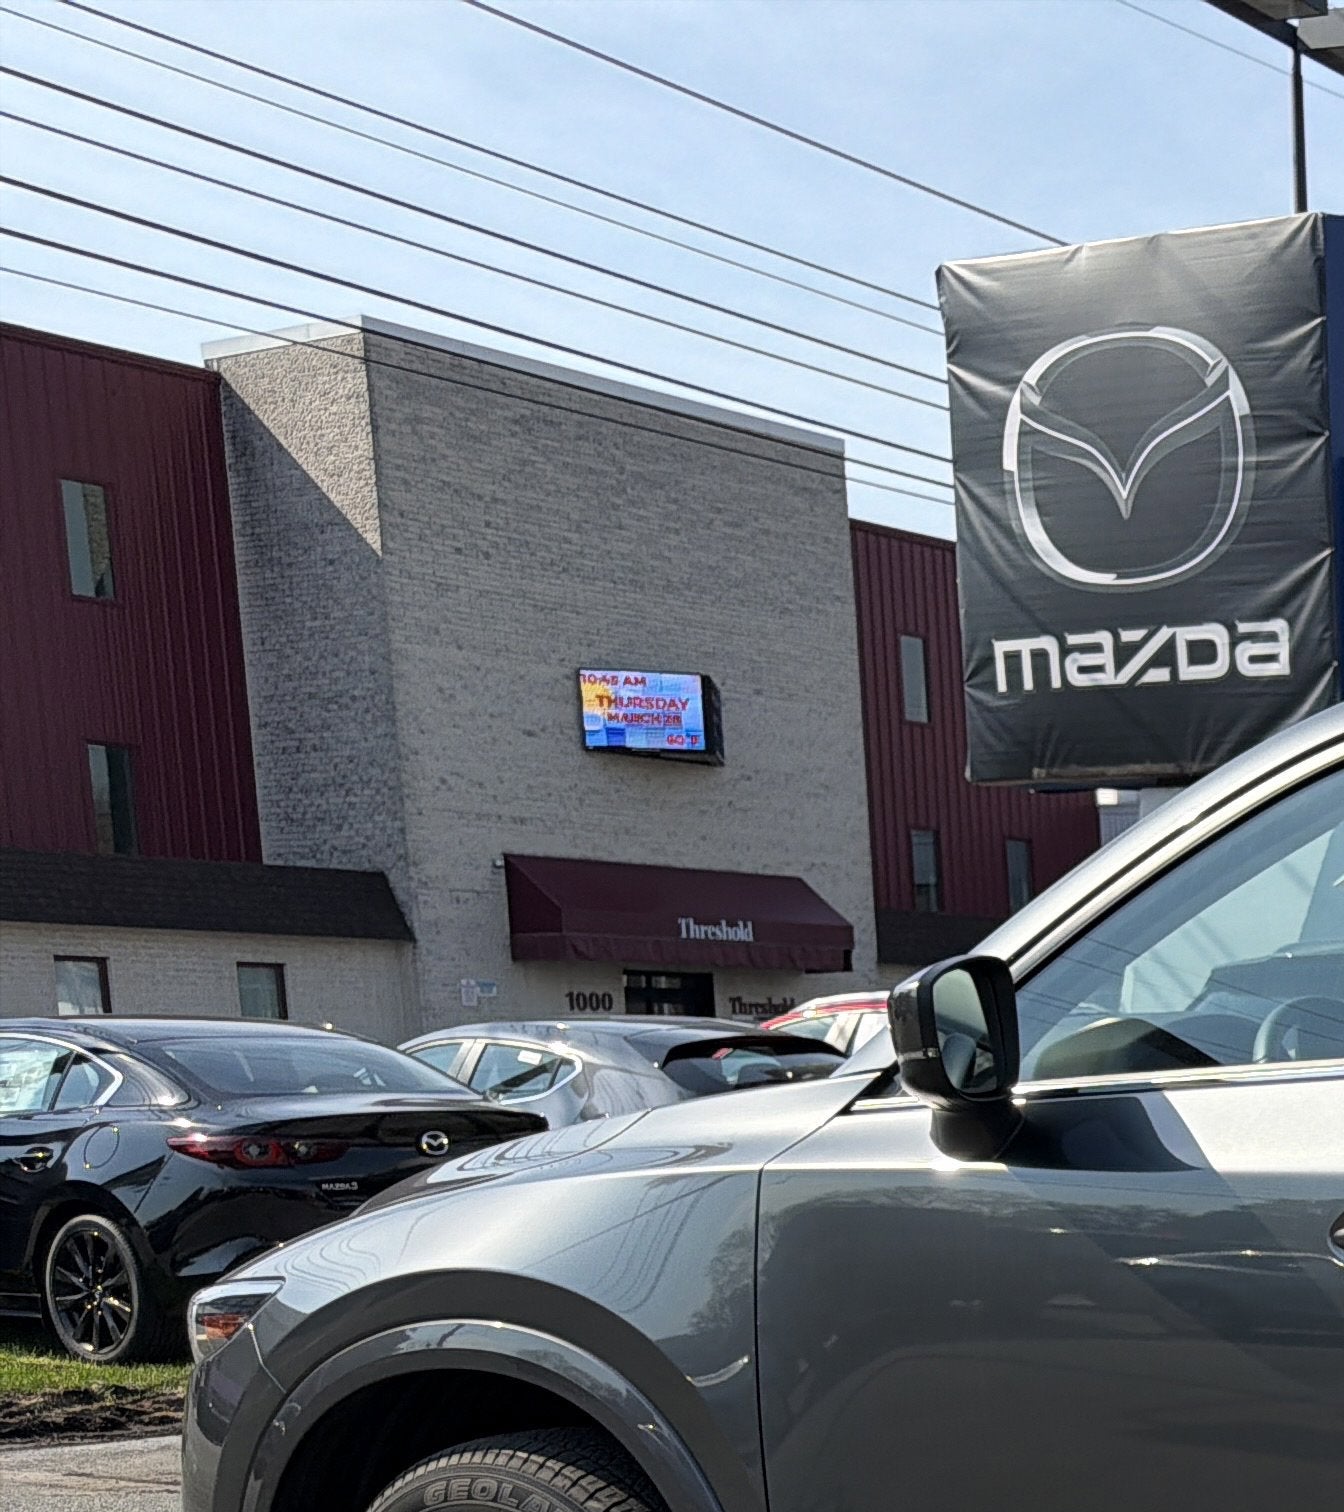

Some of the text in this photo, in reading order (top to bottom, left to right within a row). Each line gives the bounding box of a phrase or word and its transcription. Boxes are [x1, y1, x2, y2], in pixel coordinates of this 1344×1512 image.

[623, 675, 647, 687] AM
[595, 695, 689, 710] THURSDAY
[607, 712, 662, 724] MARCH
[678, 917, 754, 942] Threshold
[565, 991, 613, 1011] 1000
